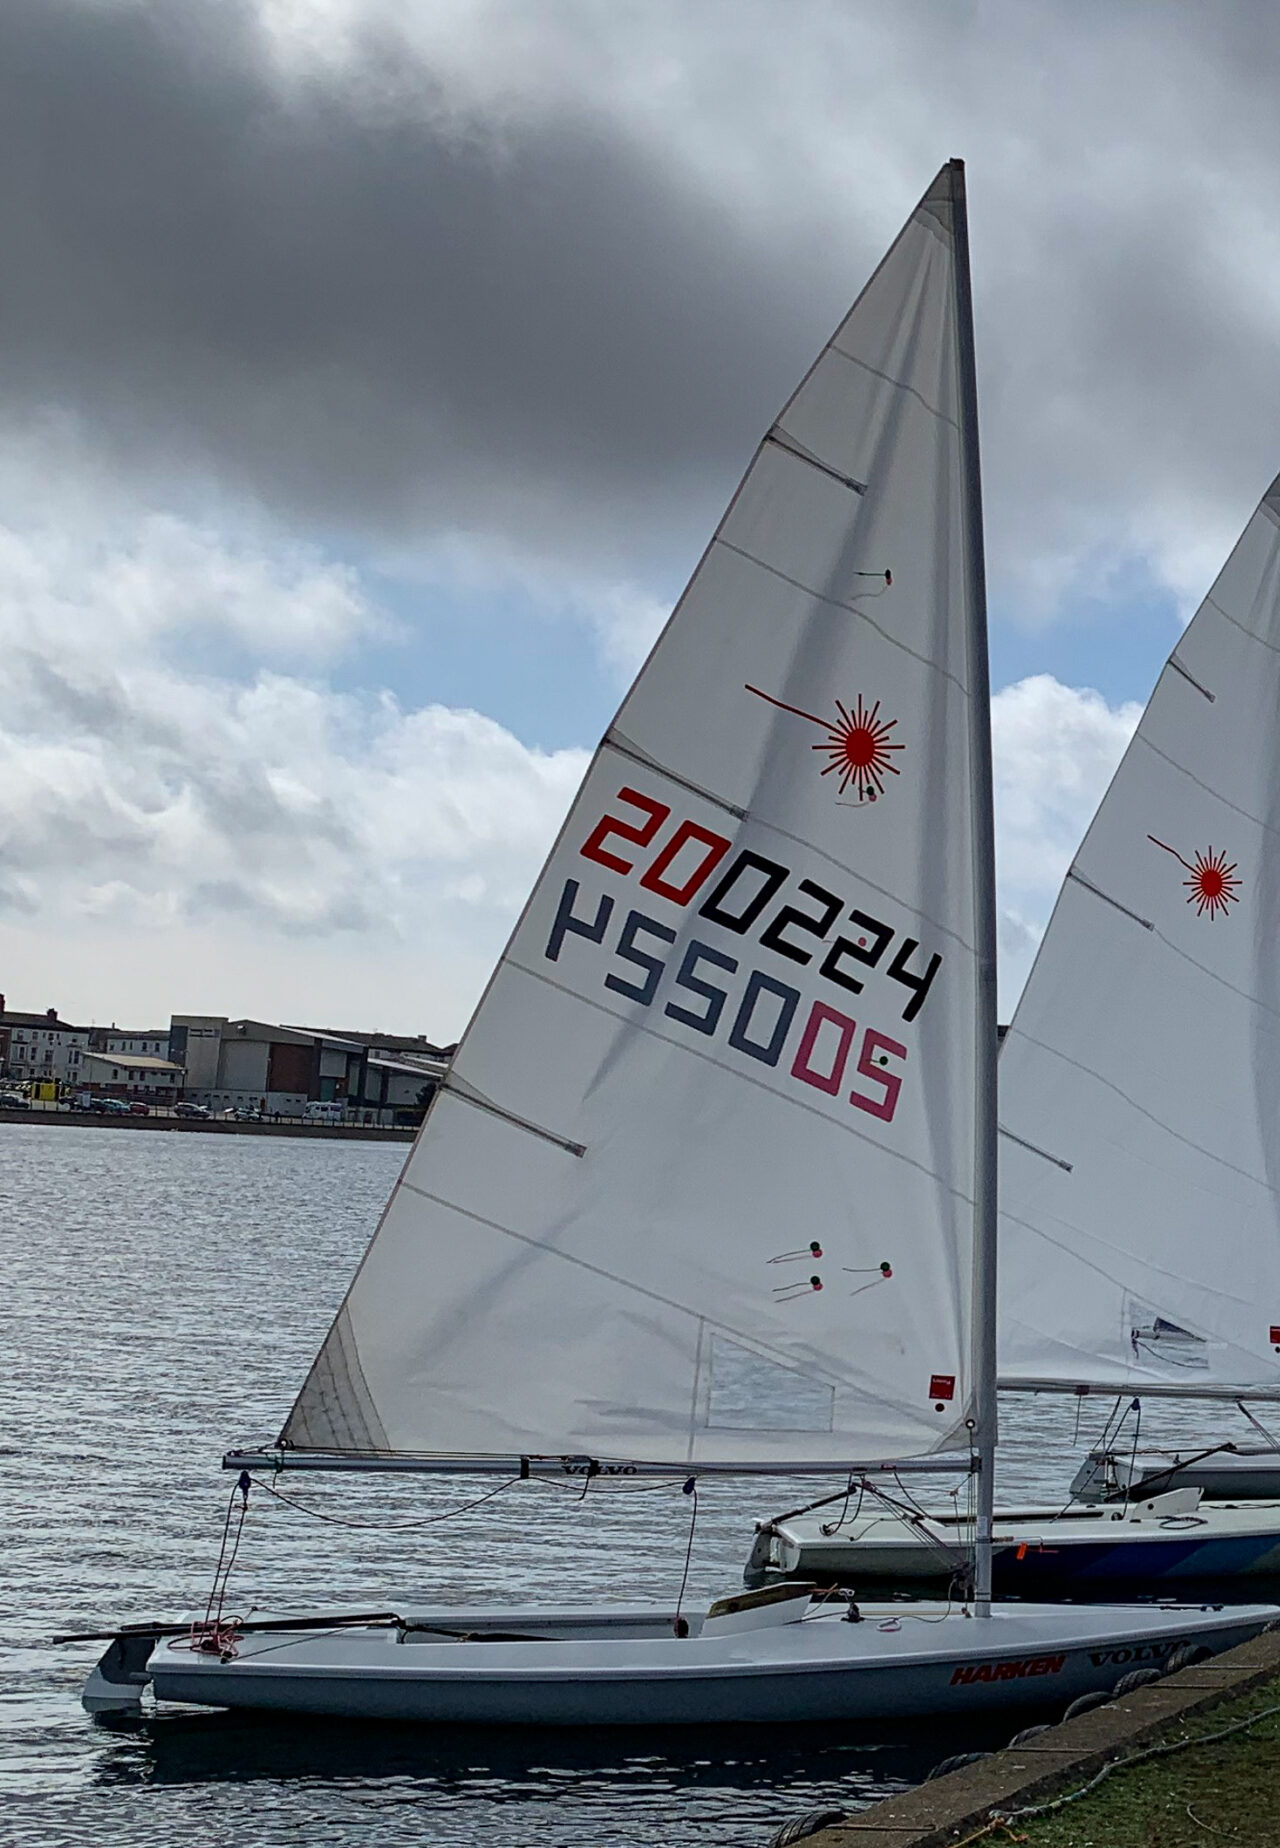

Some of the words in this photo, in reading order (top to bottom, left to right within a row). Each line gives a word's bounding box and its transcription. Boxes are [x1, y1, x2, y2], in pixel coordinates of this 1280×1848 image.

[580, 787, 942, 1022] 200224
[562, 1465, 638, 1475] VOVO
[950, 1655, 1066, 1685] HARKEN
